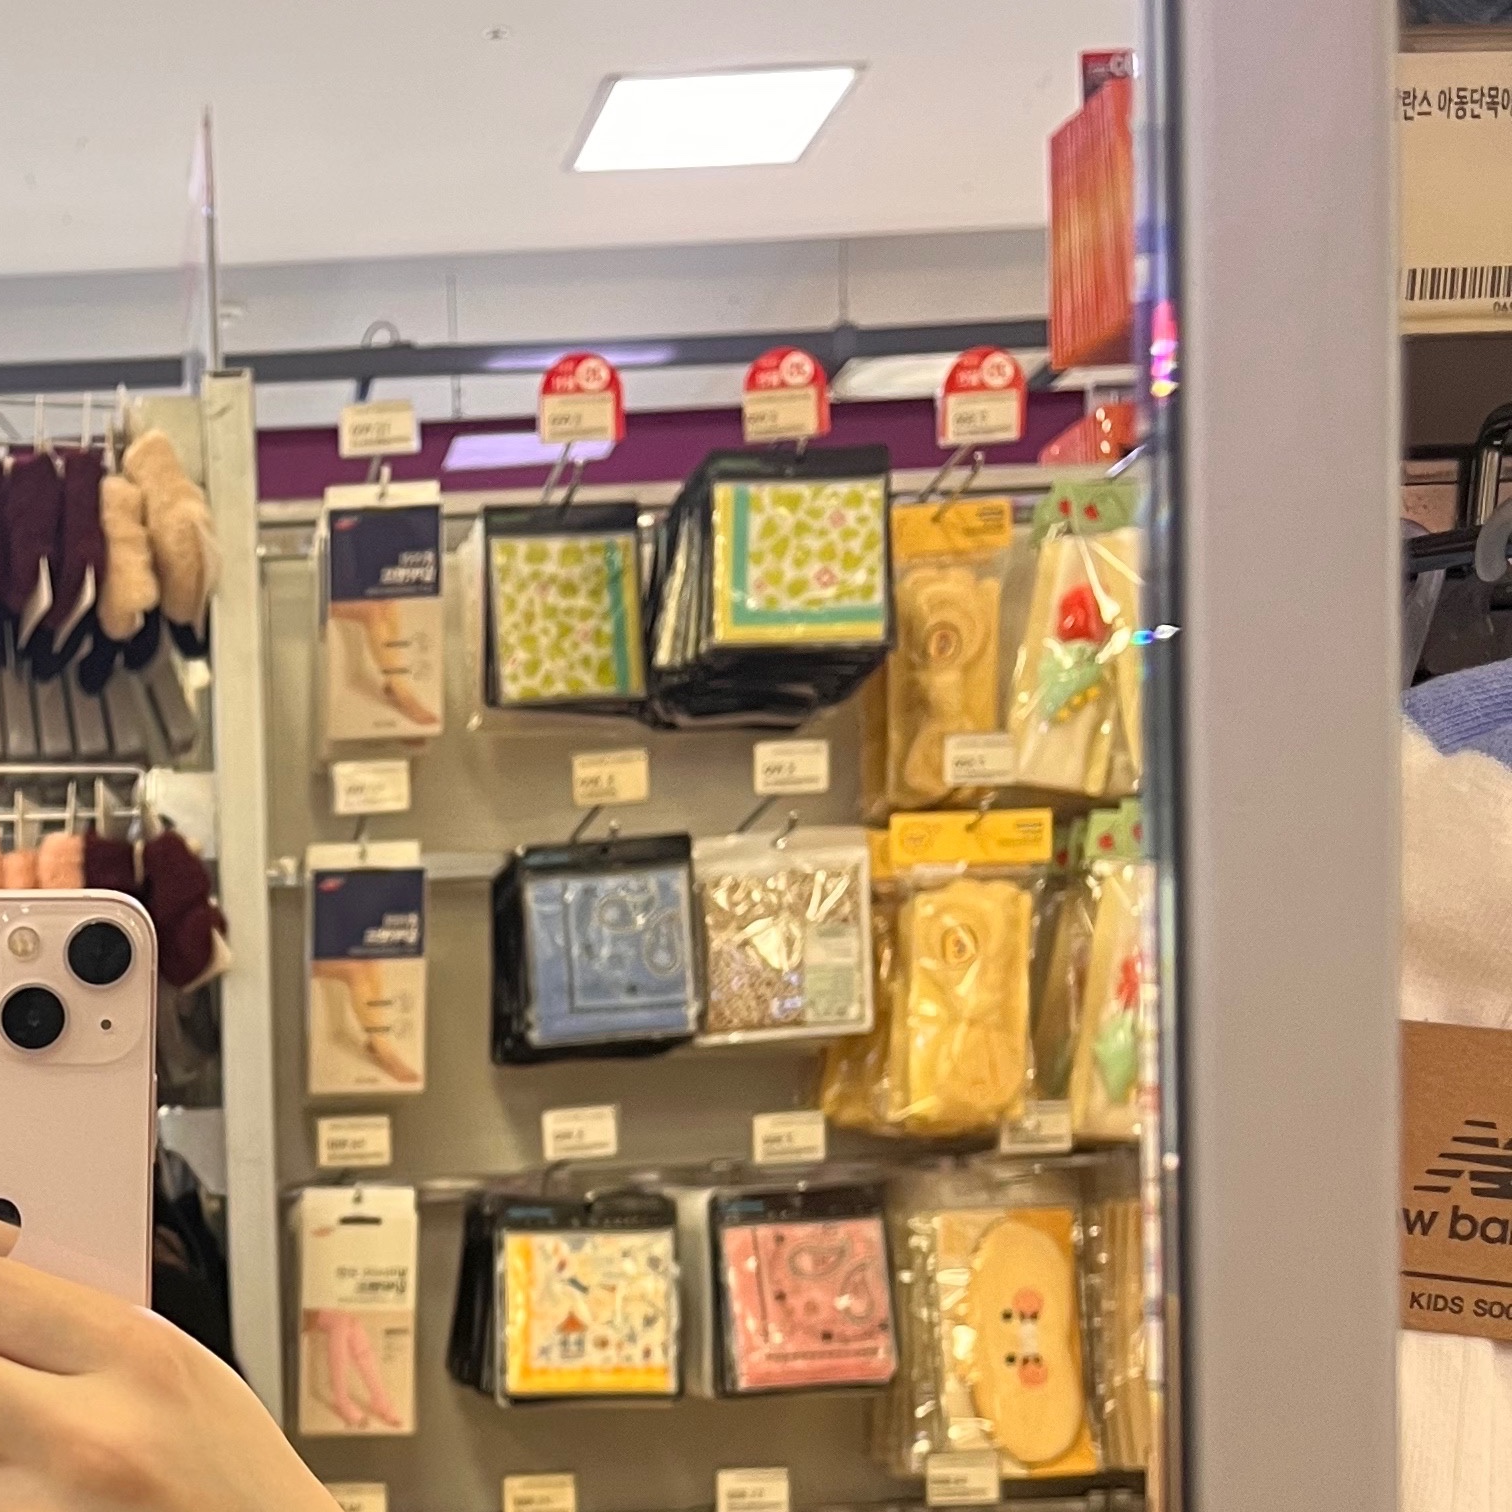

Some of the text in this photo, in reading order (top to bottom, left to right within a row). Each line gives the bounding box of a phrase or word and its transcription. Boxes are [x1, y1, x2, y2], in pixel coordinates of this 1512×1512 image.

[1396, 86, 1432, 121] 란스
[1447, 1204, 1512, 1246] ba
[1408, 1291, 1465, 1315] KIDS
